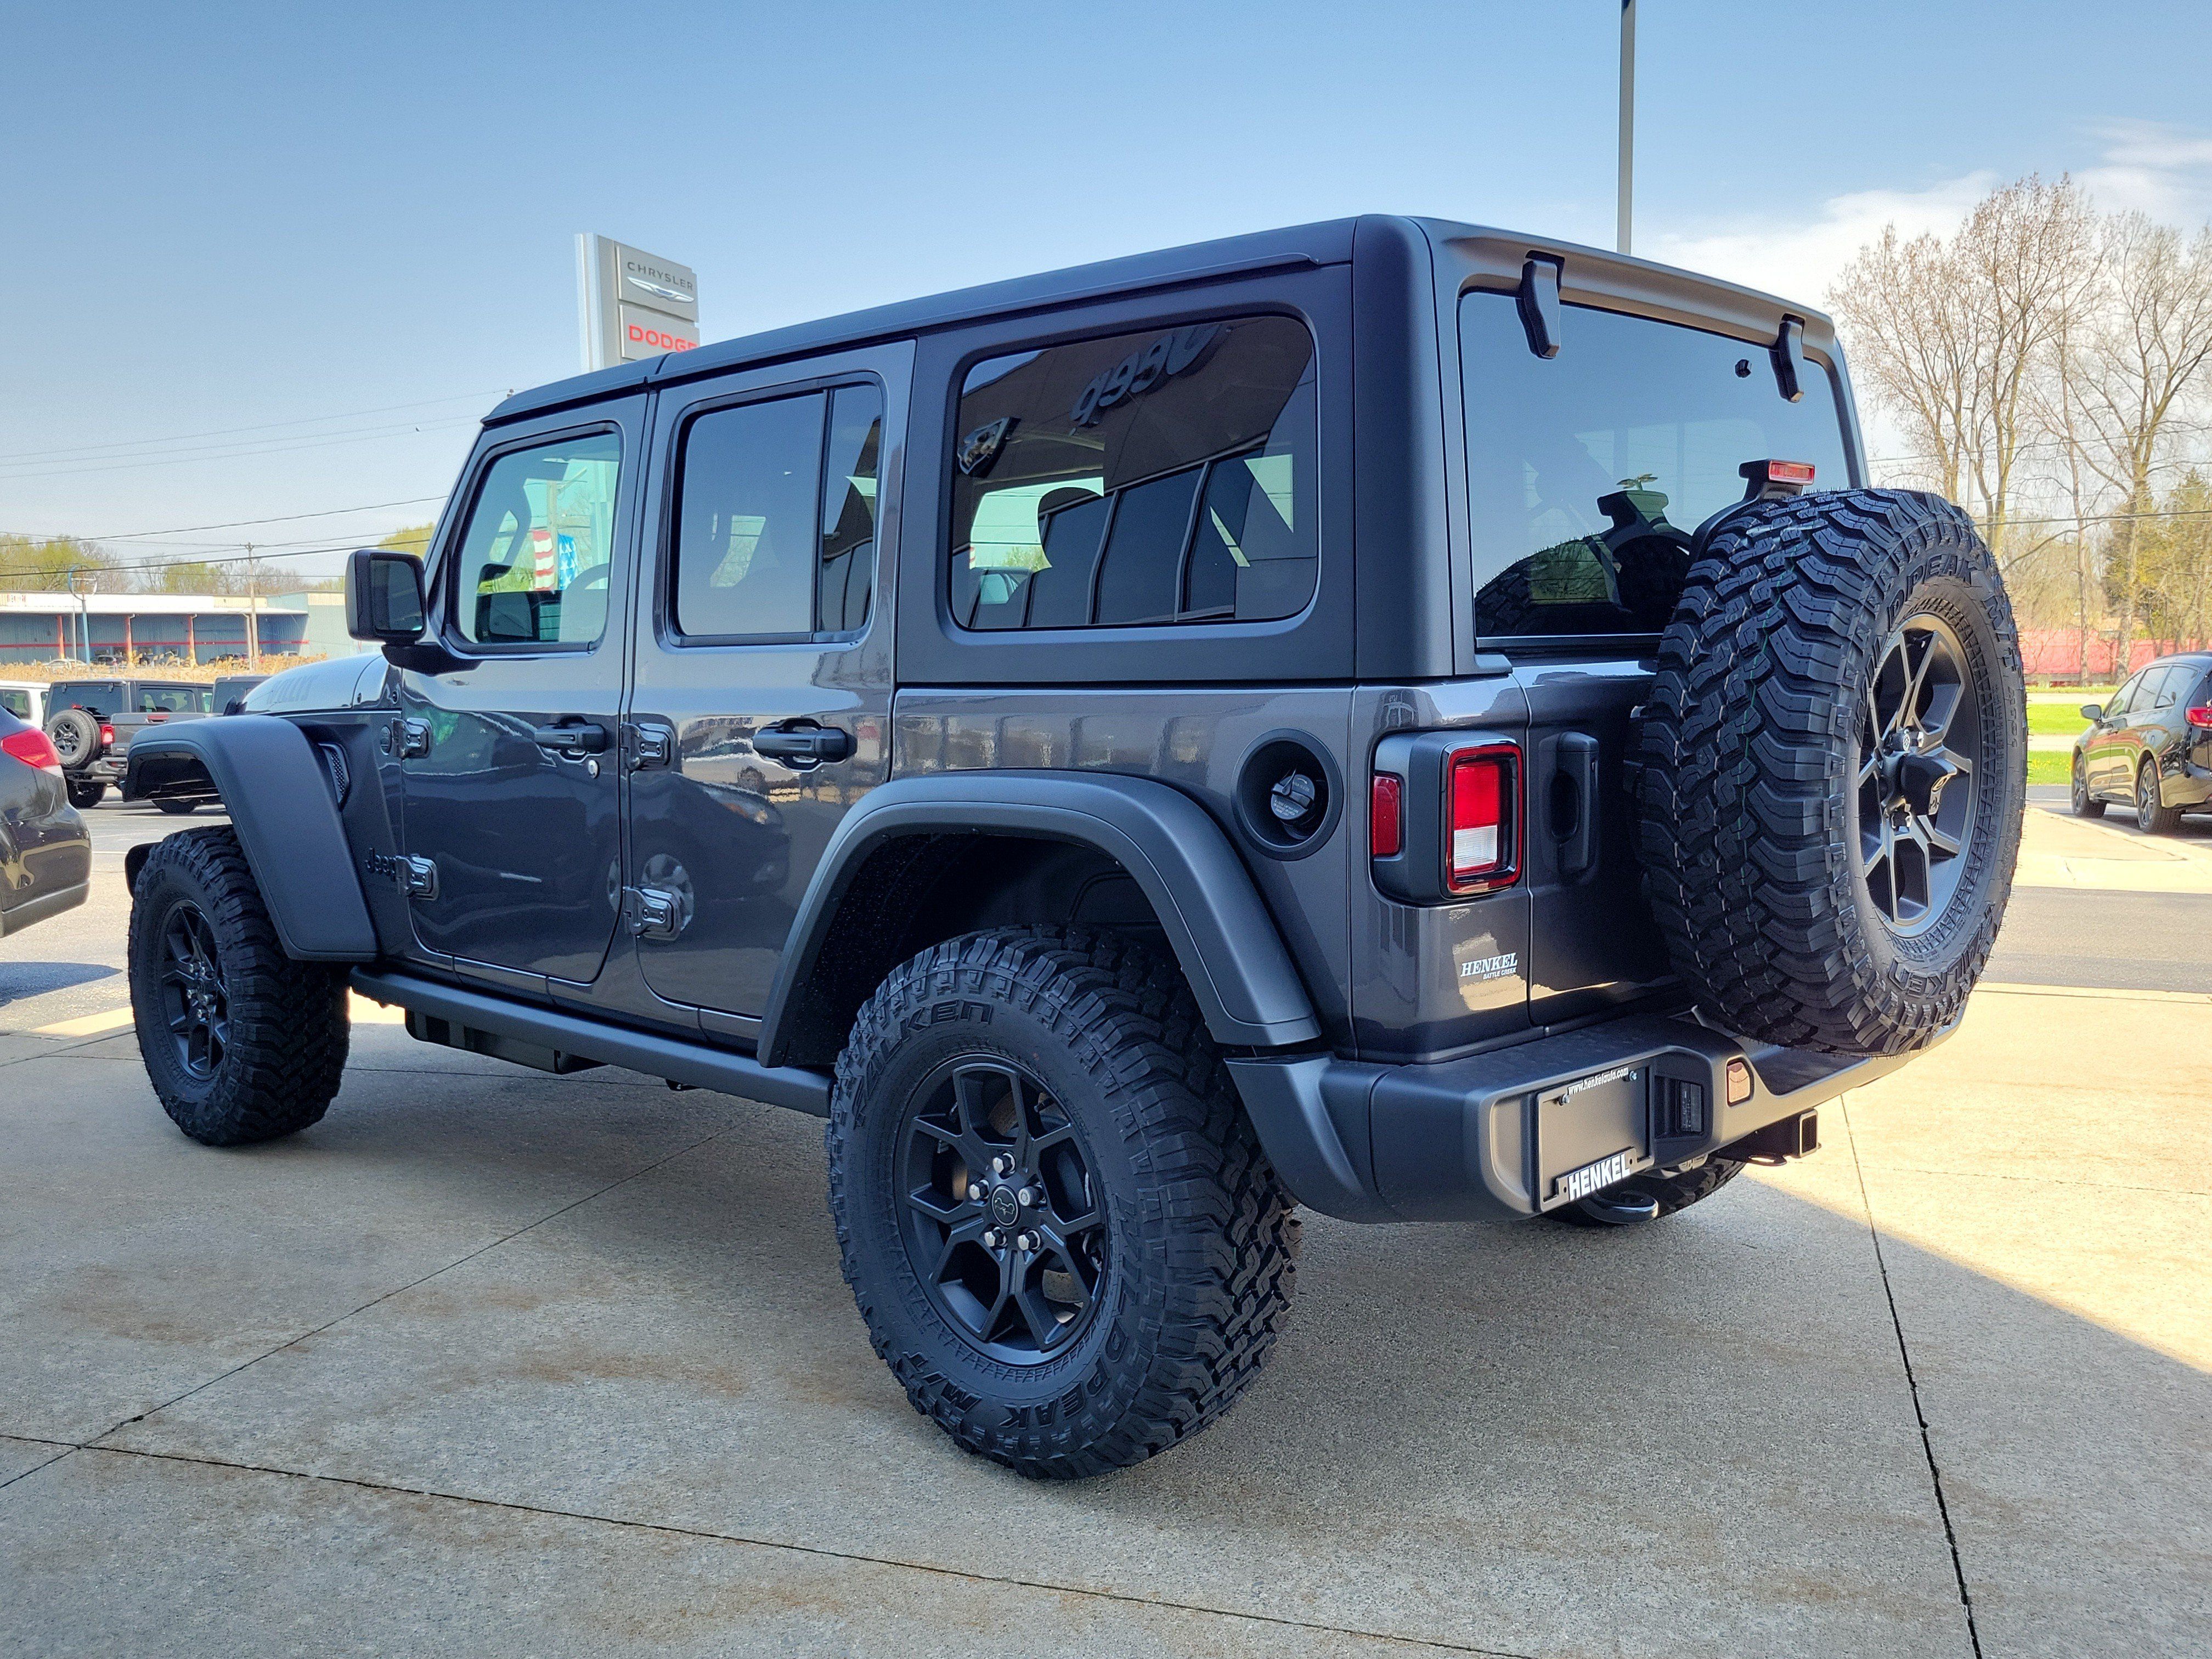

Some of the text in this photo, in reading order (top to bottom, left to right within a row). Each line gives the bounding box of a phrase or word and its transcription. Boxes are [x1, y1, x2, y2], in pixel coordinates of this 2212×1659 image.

[627, 261, 693, 291] CHRYSLER
[1460, 952, 1519, 977] HENKEL
[1483, 967, 1517, 980] BATTLE CREEK
[1568, 1066, 1629, 1096] www.henkelauto.com
[1567, 1152, 1630, 1201] HENKEL
